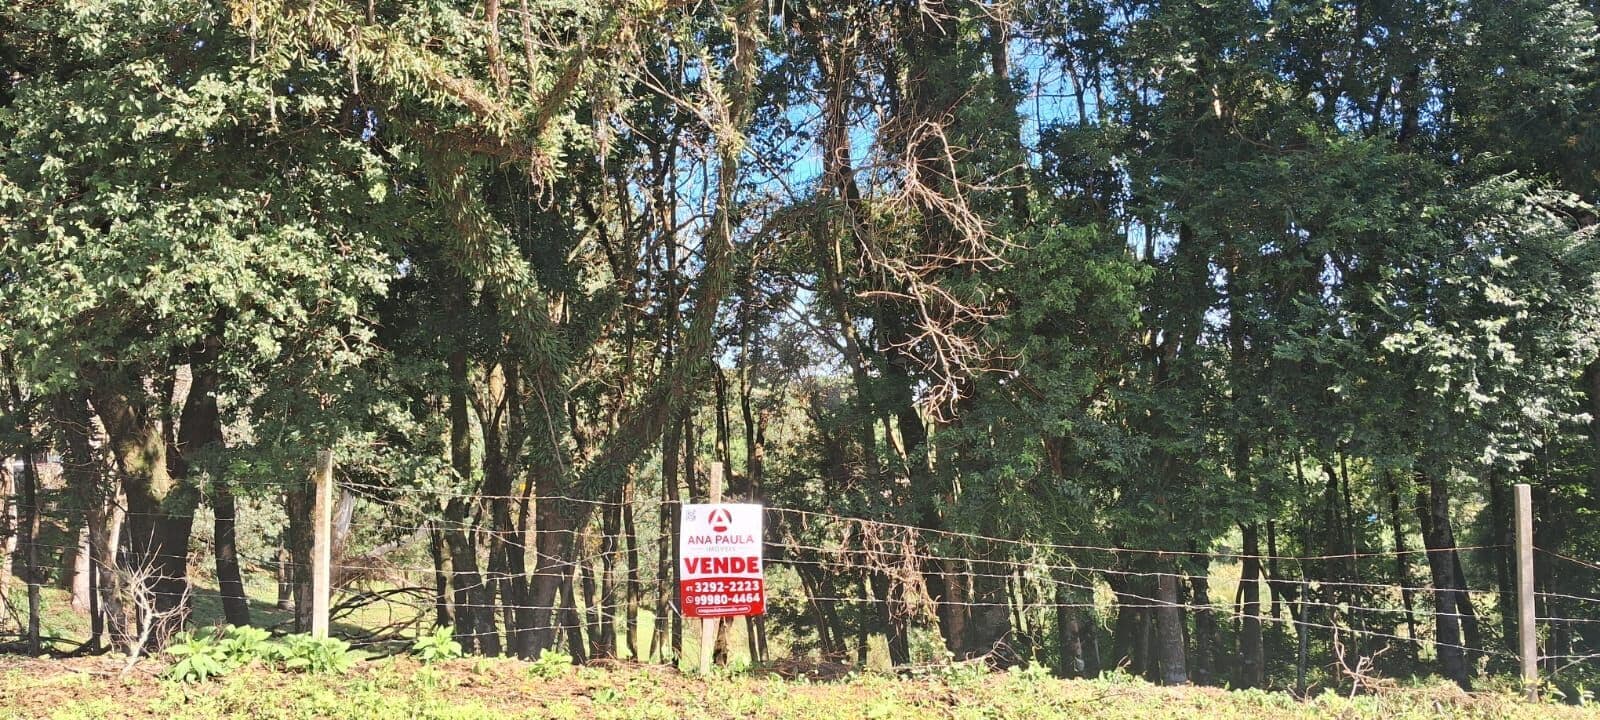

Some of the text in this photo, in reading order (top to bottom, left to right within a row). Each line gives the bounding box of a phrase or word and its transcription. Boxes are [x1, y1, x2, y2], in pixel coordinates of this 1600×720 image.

[687, 534, 754, 545] ANA PAULA
[683, 556, 760, 574] VENDE
[694, 580, 760, 593] 3292-2223
[694, 593, 760, 605] 99980-4464
